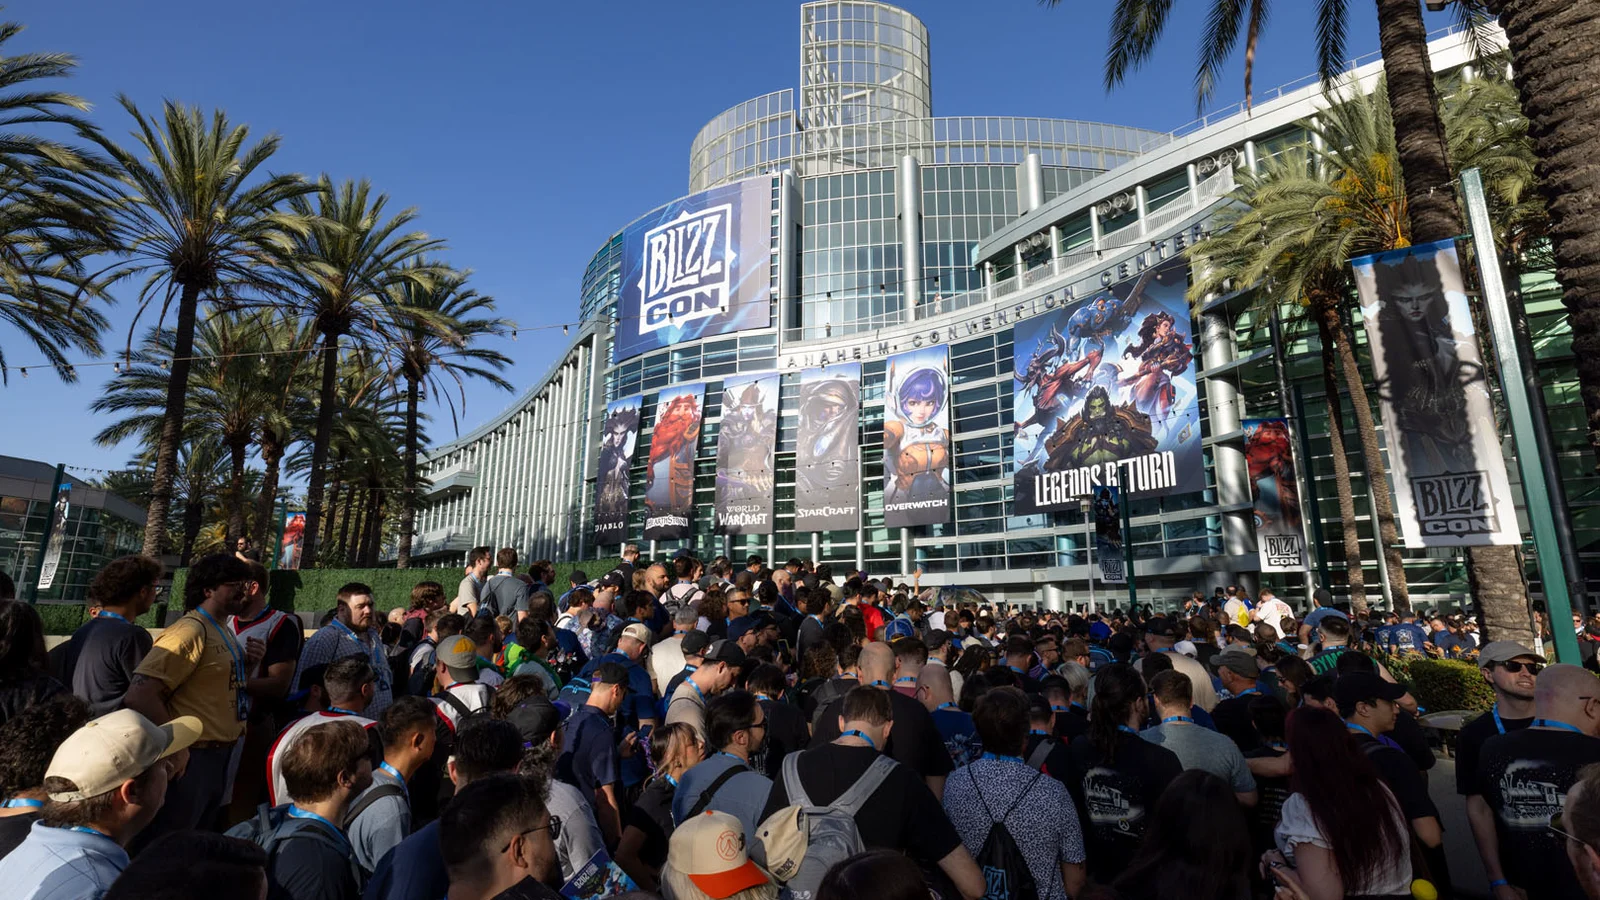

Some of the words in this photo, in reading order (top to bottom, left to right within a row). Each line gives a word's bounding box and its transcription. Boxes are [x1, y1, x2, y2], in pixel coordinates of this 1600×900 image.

[648, 214, 722, 298] BLIZZ
[646, 288, 720, 326] CON
[787, 342, 890, 368] ANAHEIM
[912, 286, 1076, 348] CONVENTION
[1100, 224, 1205, 287] CENTER
[1035, 464, 1102, 507] LEGENDS
[1416, 475, 1489, 517] BLIZZ
[726, 505, 760, 513] WORLD
[885, 499, 948, 512] OVERWATCH
[594, 521, 624, 533] DIABLO
[1425, 517, 1492, 534] CON
[1268, 537, 1298, 557] BLIZZ
